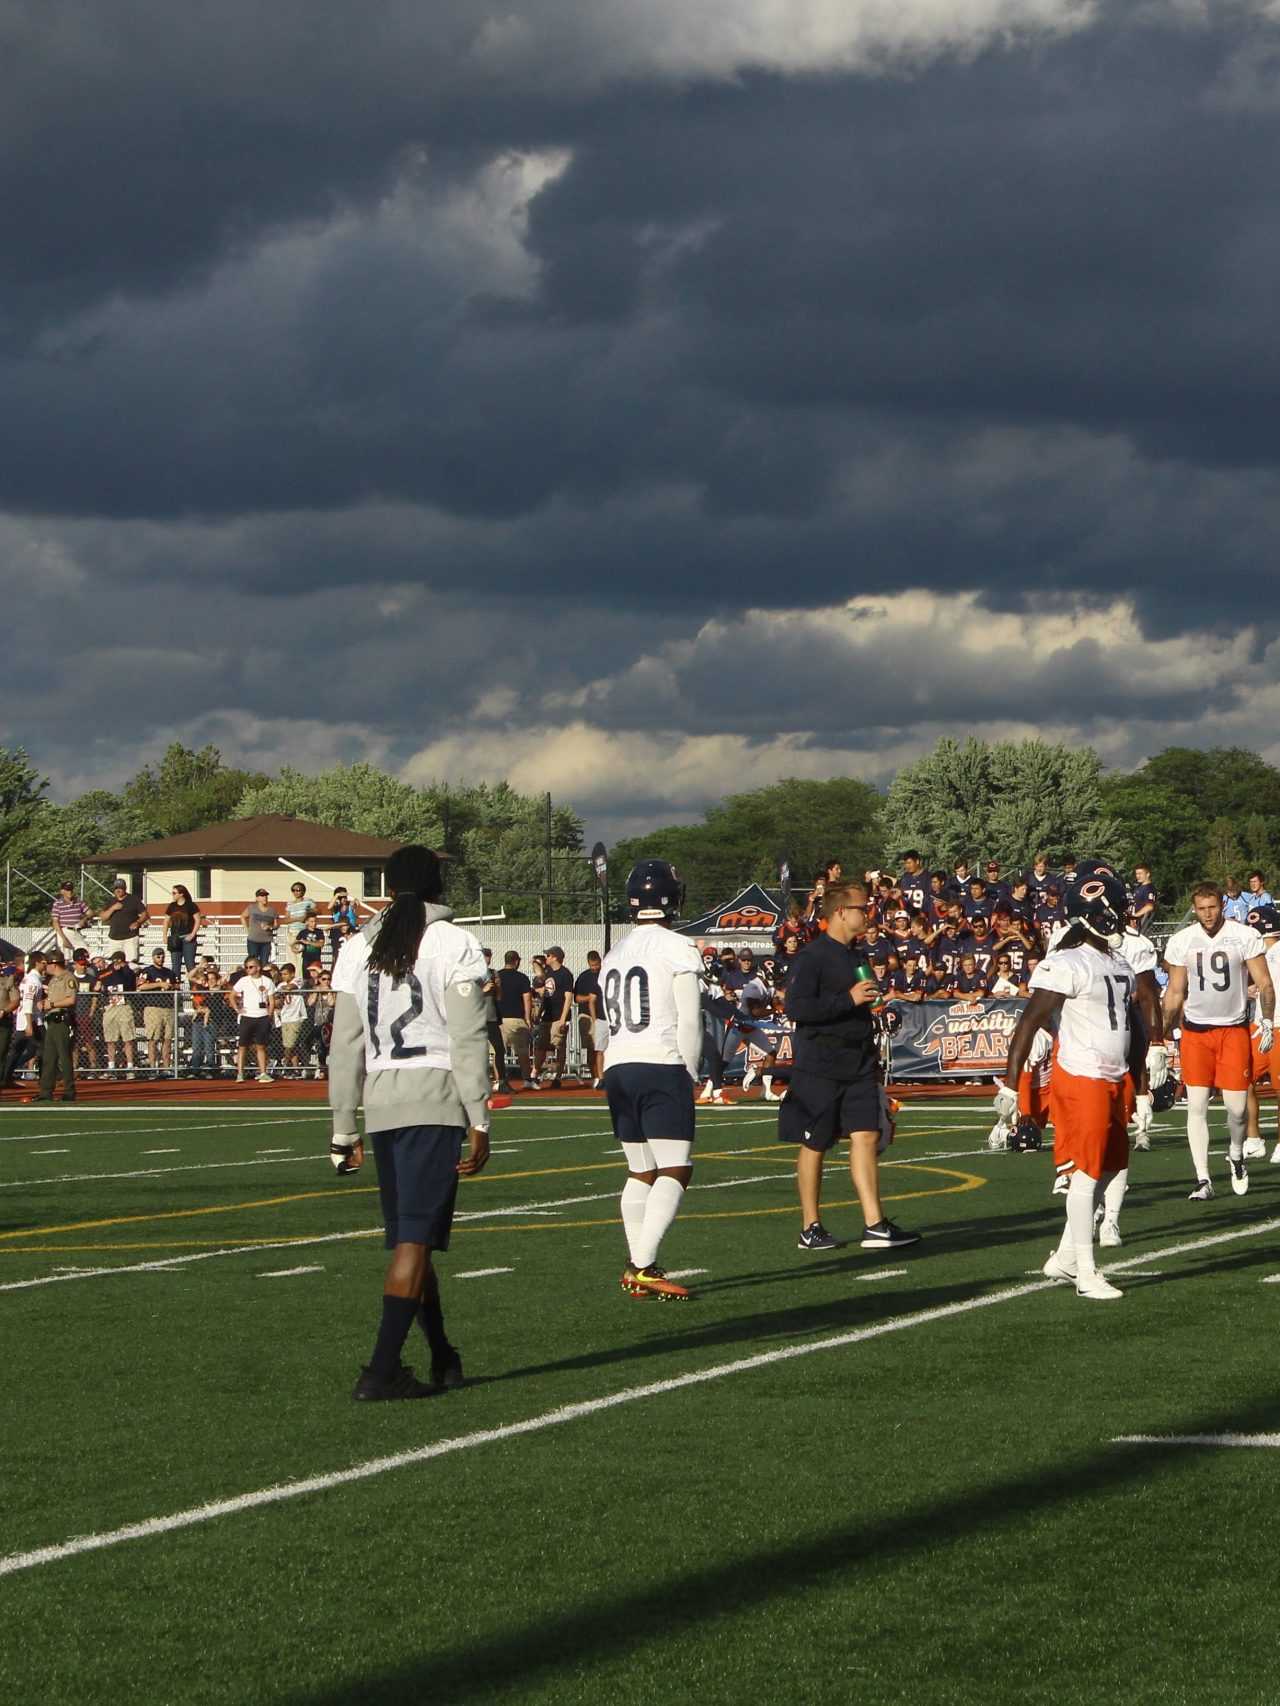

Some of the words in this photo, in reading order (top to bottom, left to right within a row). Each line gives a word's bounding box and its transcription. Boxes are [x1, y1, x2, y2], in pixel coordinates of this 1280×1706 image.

[904, 889, 924, 908] 79
[1196, 951, 1231, 992] 19
[366, 970, 427, 1060] 12
[605, 966, 651, 1036] 80
[1104, 975, 1131, 1031] 17
[941, 1033, 1014, 1060] BEAR
